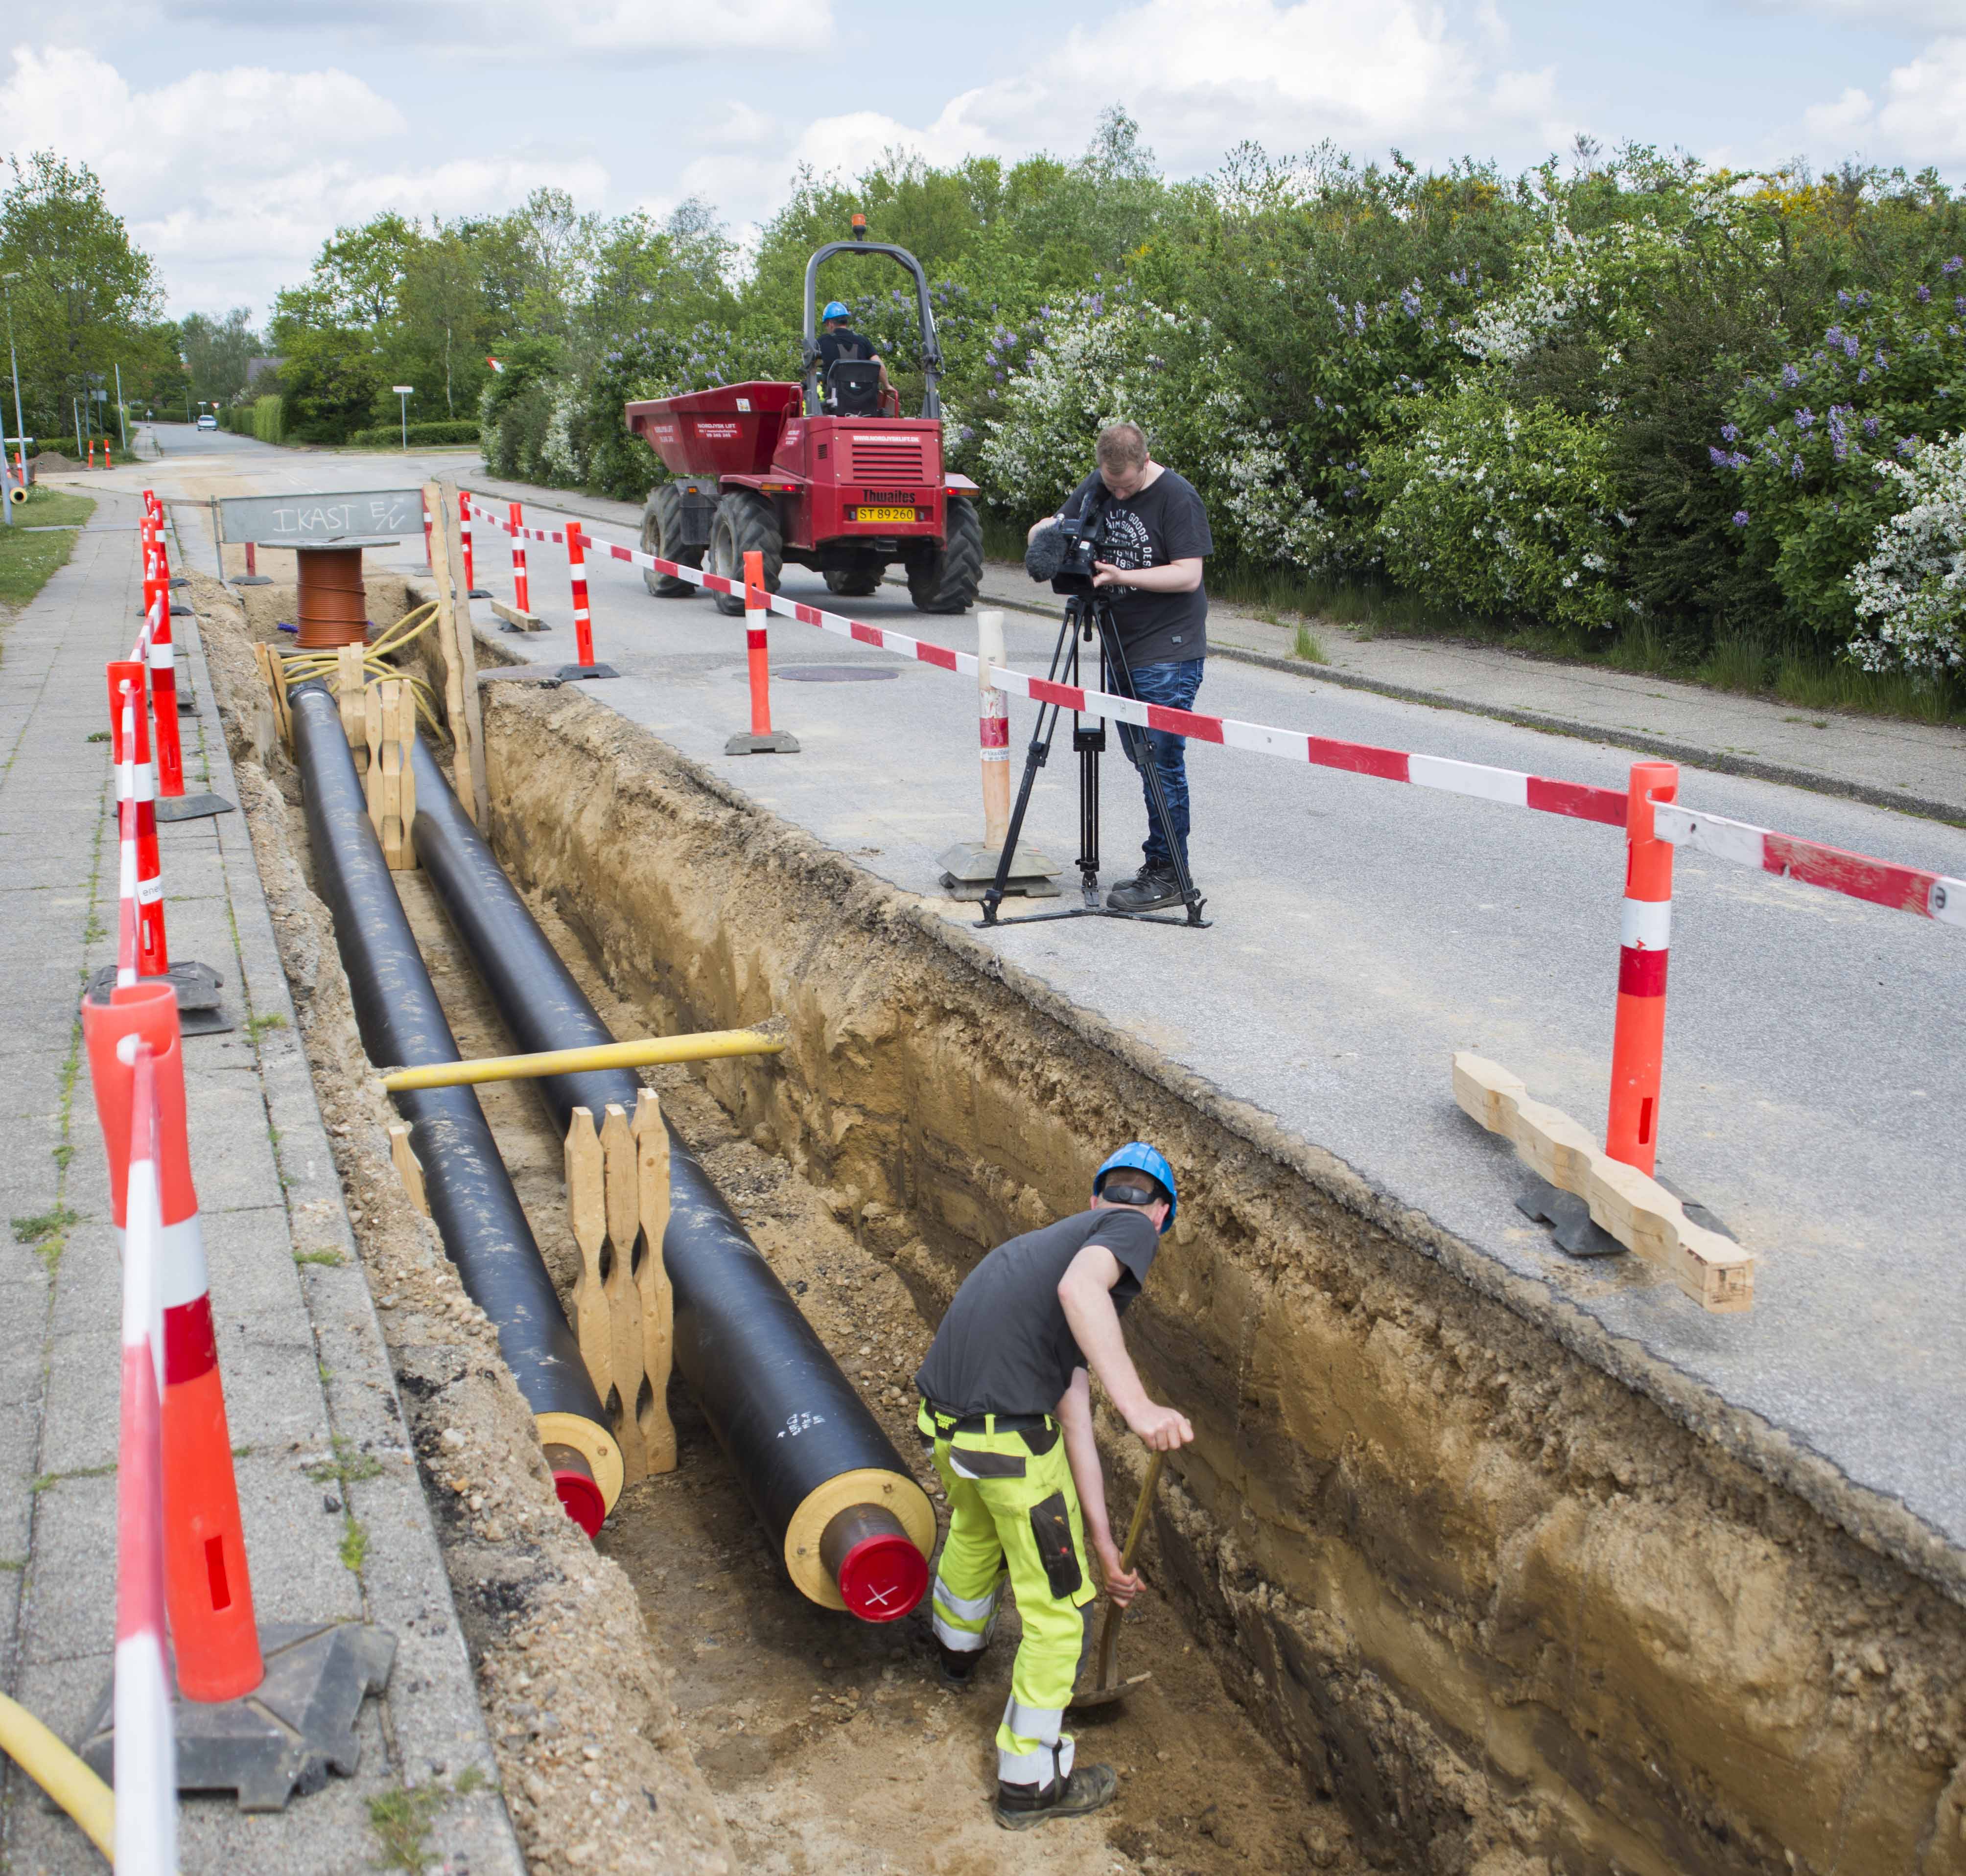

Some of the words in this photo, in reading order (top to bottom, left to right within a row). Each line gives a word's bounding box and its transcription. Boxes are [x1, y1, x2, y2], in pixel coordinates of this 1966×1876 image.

[863, 489, 915, 504] Thwaites
[273, 504, 357, 532] IKAST
[860, 509, 874, 519] ST
[877, 509, 890, 519] 89
[893, 509, 913, 519] 260
[1128, 513, 1149, 542] GOODS
[1121, 521, 1140, 548] SUPPLY
